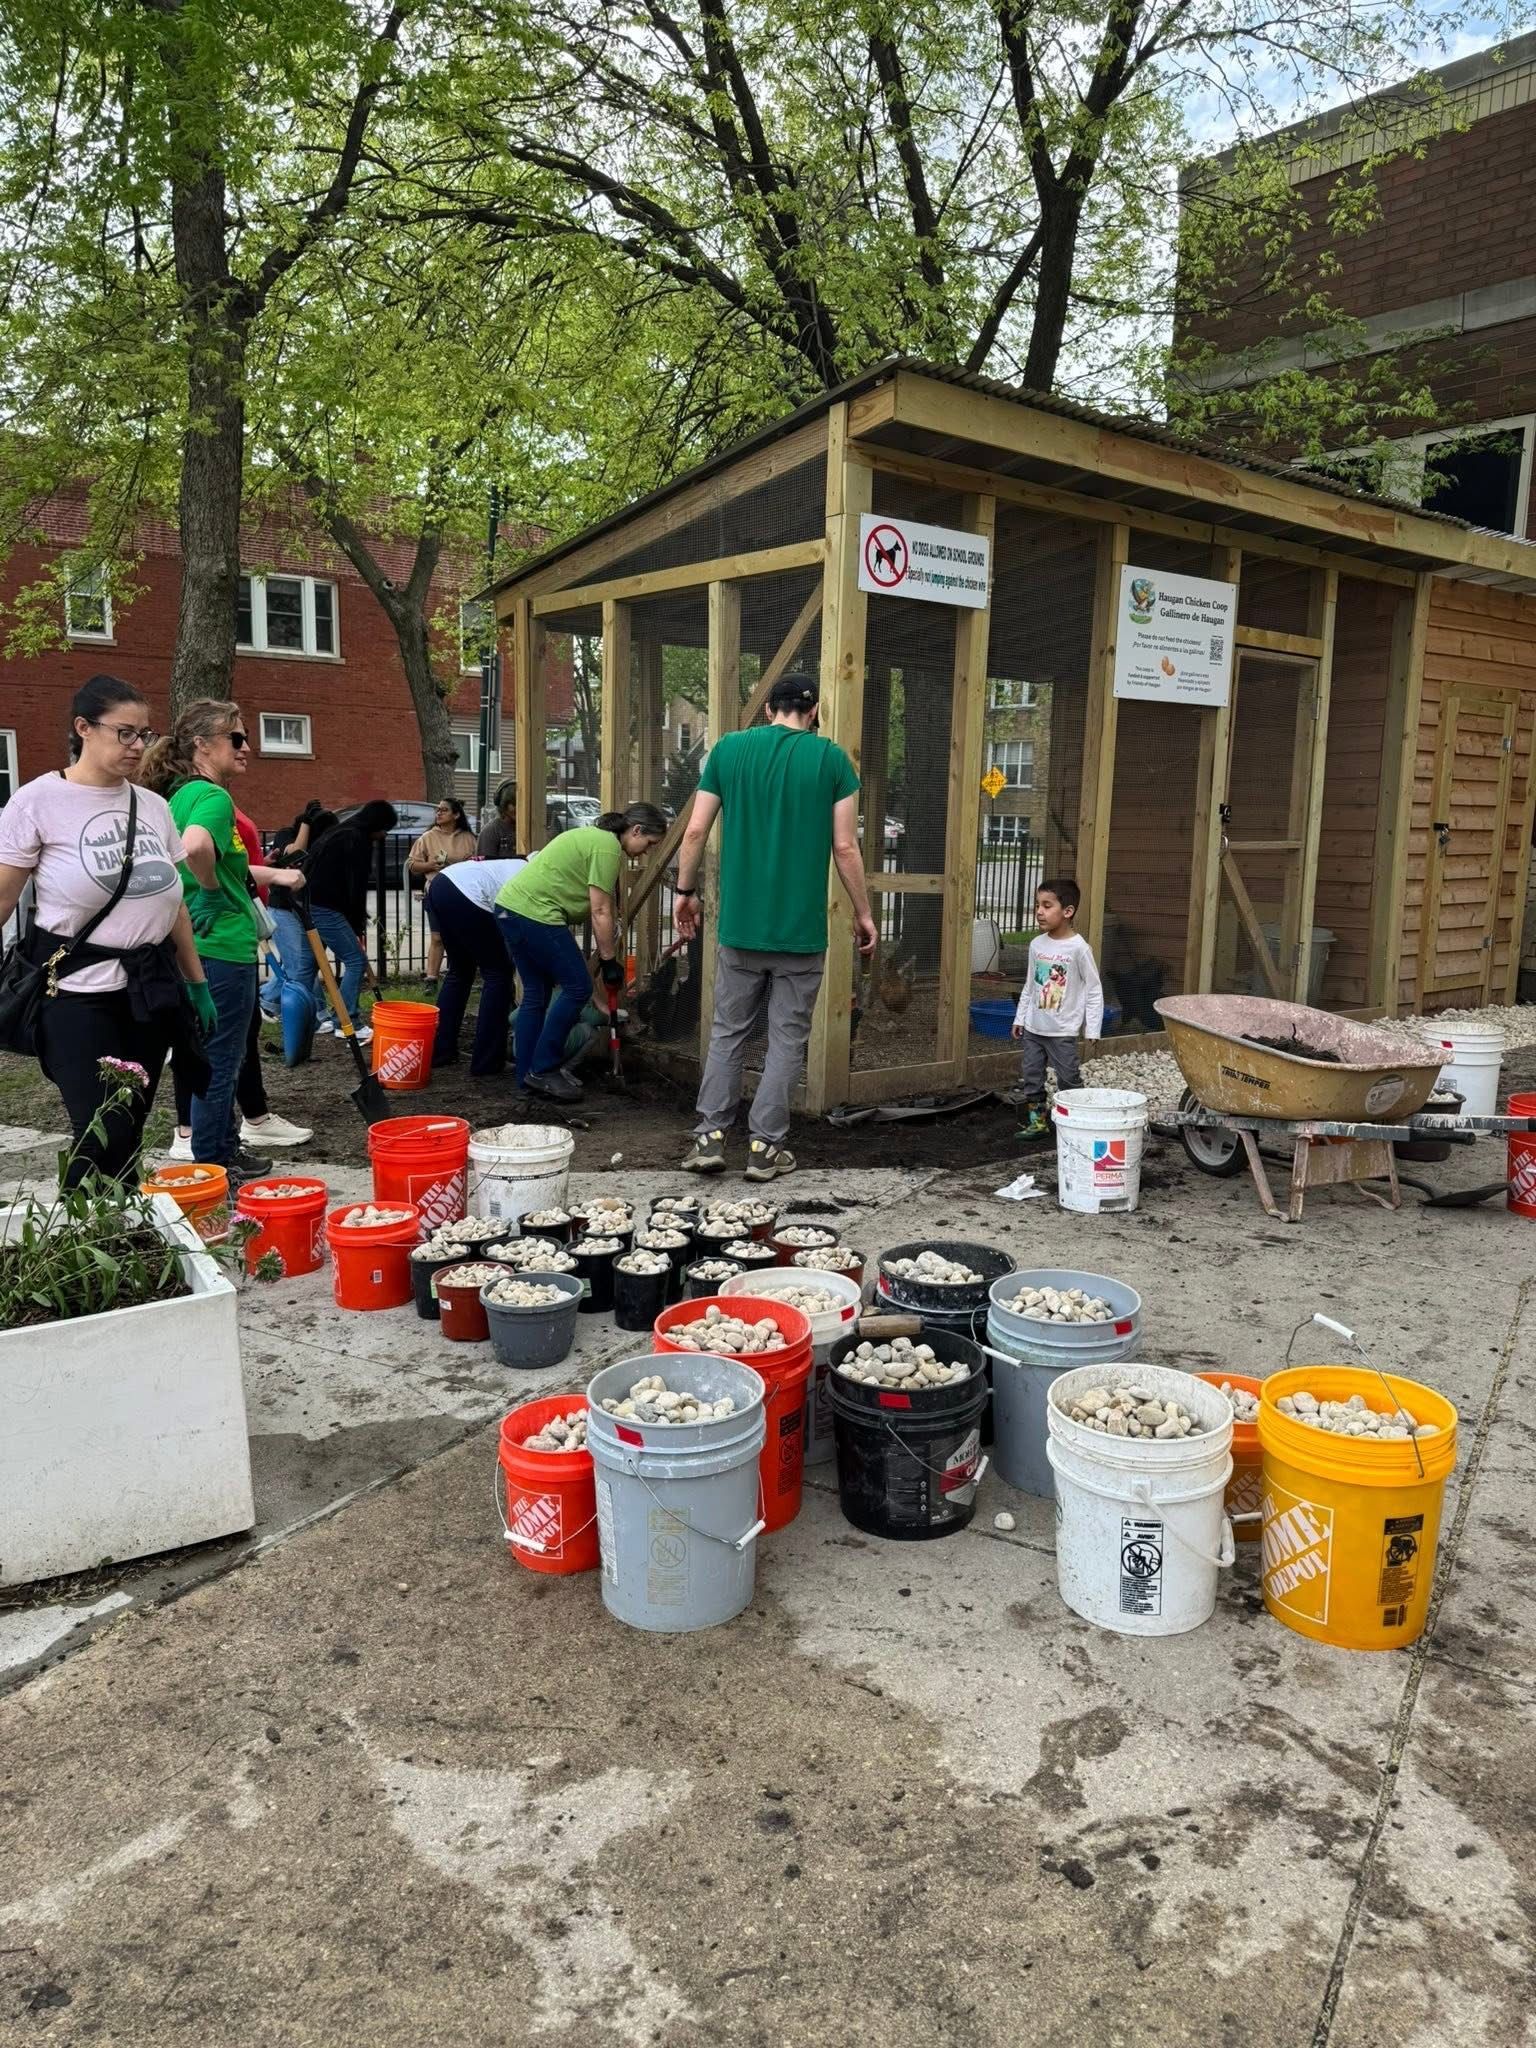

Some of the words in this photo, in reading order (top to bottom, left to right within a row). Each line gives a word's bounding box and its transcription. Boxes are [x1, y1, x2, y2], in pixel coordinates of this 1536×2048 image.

[912, 540, 918, 555] NO
[918, 542, 929, 557] DOGS
[930, 544, 946, 560] ALLOWED
[946, 546, 952, 561] ON
[952, 548, 968, 564] SCHOOL
[968, 550, 985, 567] GROUNDS
[1158, 592, 1184, 605] Haugan
[1184, 596, 1211, 608] Chicken
[1212, 600, 1228, 612] Coop
[1160, 608, 1191, 620] Gallinero
[1192, 612, 1200, 622] de
[1201, 614, 1225, 626] Haugan
[1137, 632, 1151, 640] Please
[380, 1040, 421, 1080] HOME
[384, 1043, 402, 1059] THE
[393, 1056, 421, 1081] DEPOT
[1240, 1071, 1271, 1090] TEMPER
[1513, 1150, 1534, 1171] THE
[416, 1180, 444, 1208] THE
[1231, 1472, 1256, 1496] THE
[512, 1496, 531, 1518] THE
[1269, 1548, 1328, 1599] DEPOT
